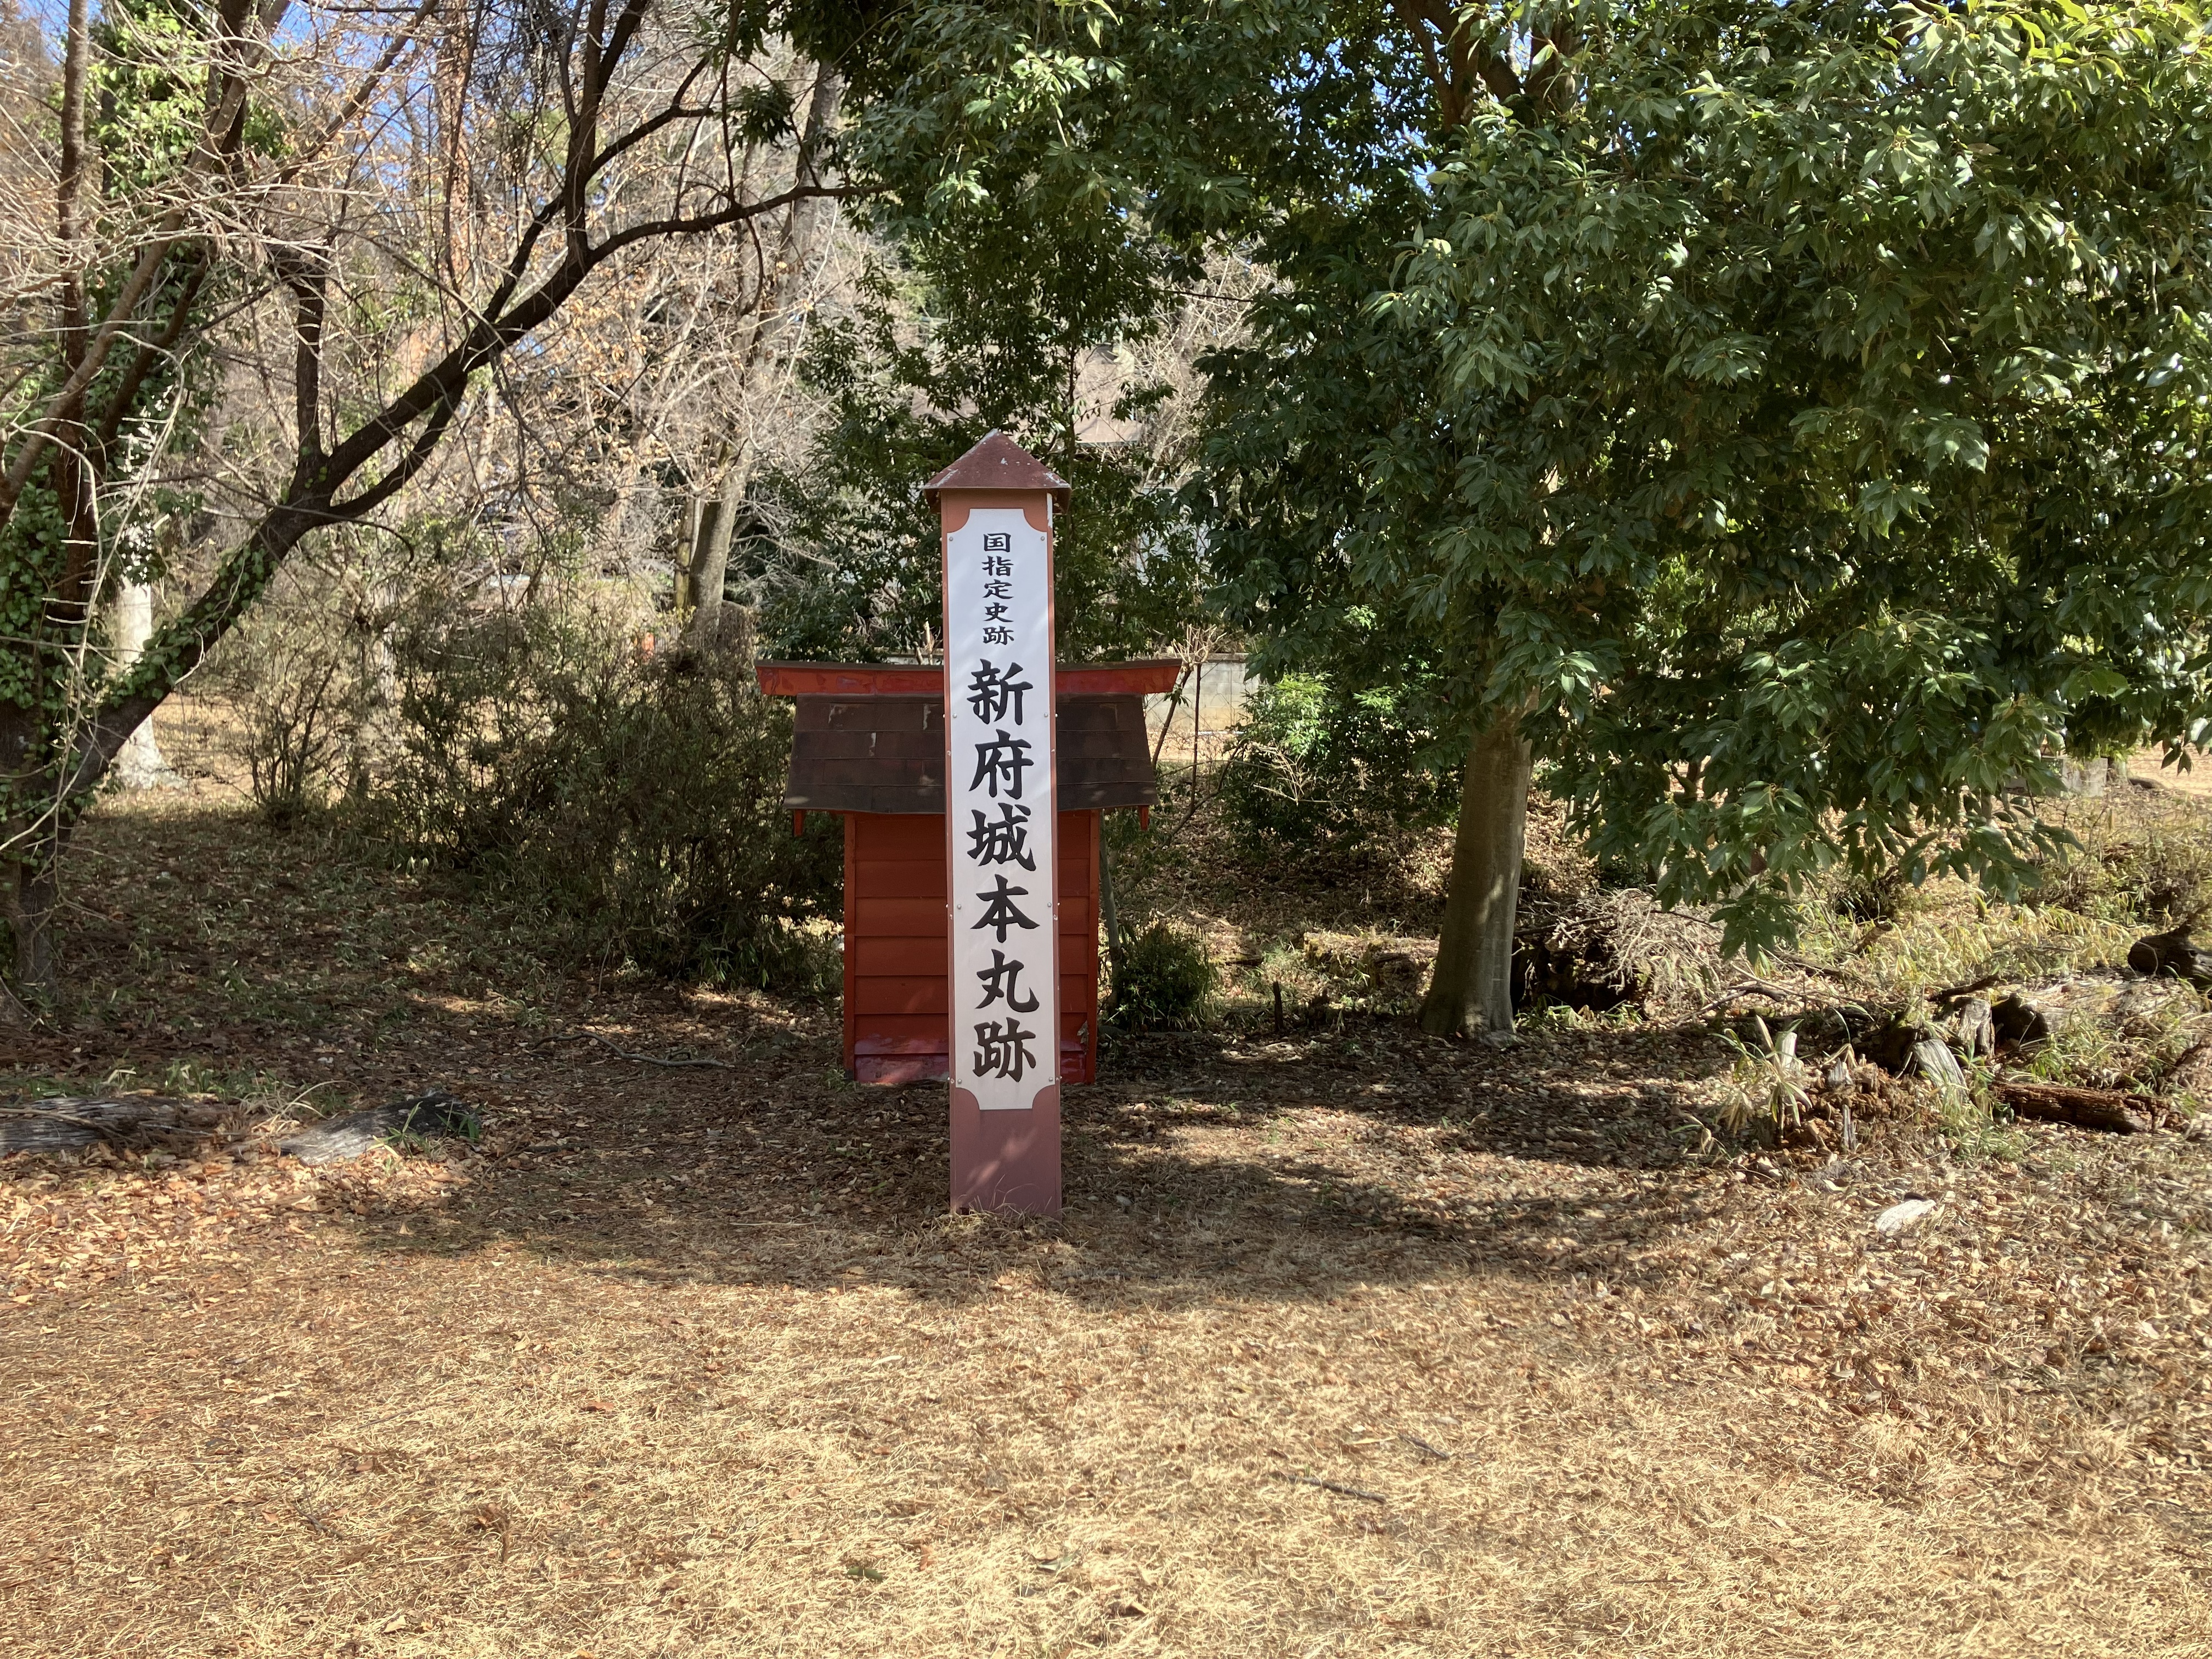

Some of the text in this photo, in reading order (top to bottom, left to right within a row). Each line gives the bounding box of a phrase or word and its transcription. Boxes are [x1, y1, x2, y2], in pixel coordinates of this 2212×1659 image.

[981, 532, 1014, 645] 国指定史跡
[966, 658, 1040, 1082] 新府城本丸跡
